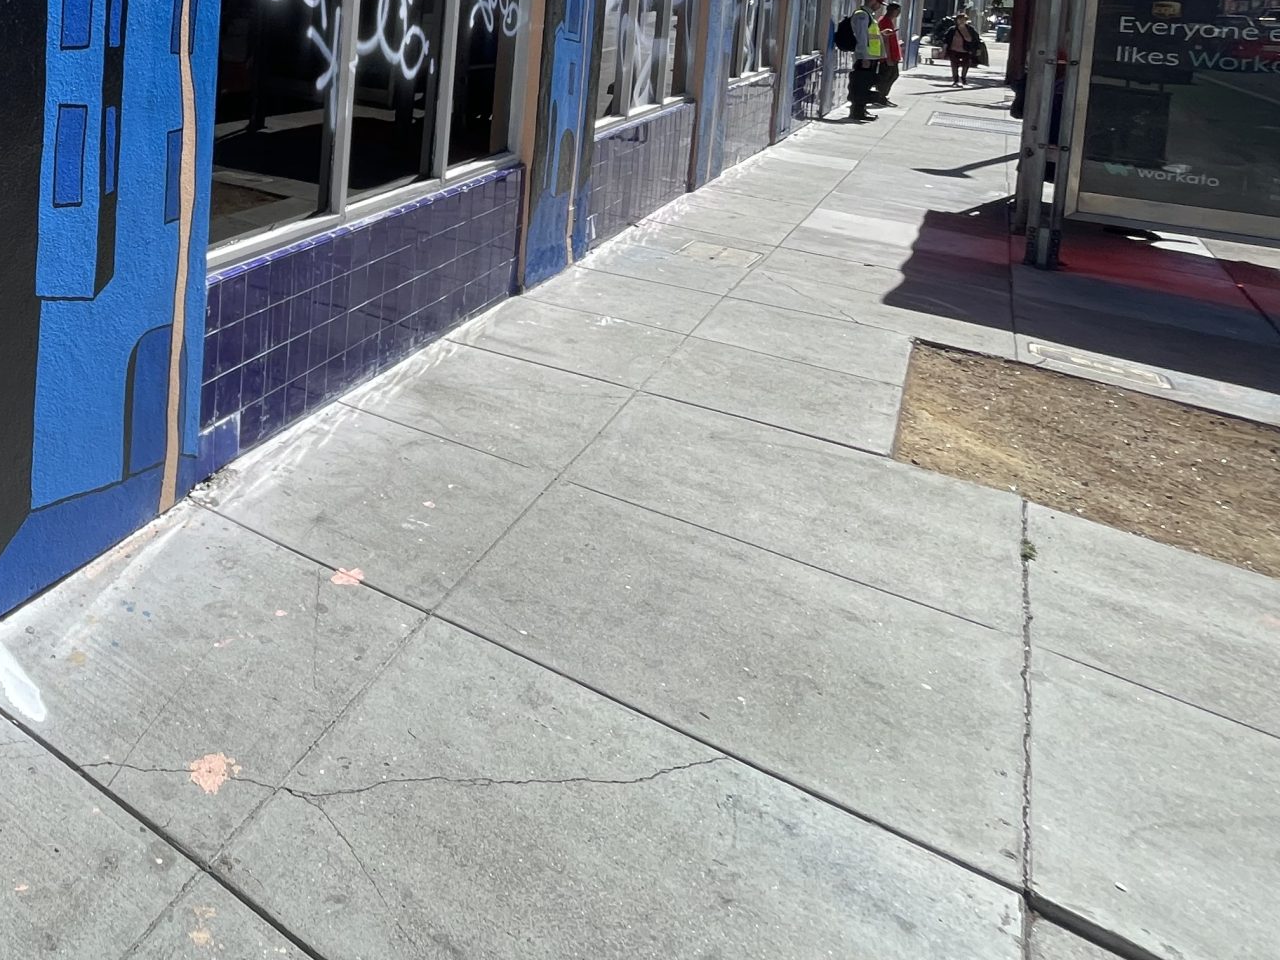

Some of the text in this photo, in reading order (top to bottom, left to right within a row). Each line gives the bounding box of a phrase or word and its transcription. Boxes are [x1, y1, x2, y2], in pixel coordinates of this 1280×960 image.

[1119, 16, 1259, 41] Everyone
[1115, 45, 1180, 66] likes
[1137, 167, 1220, 187] workato
